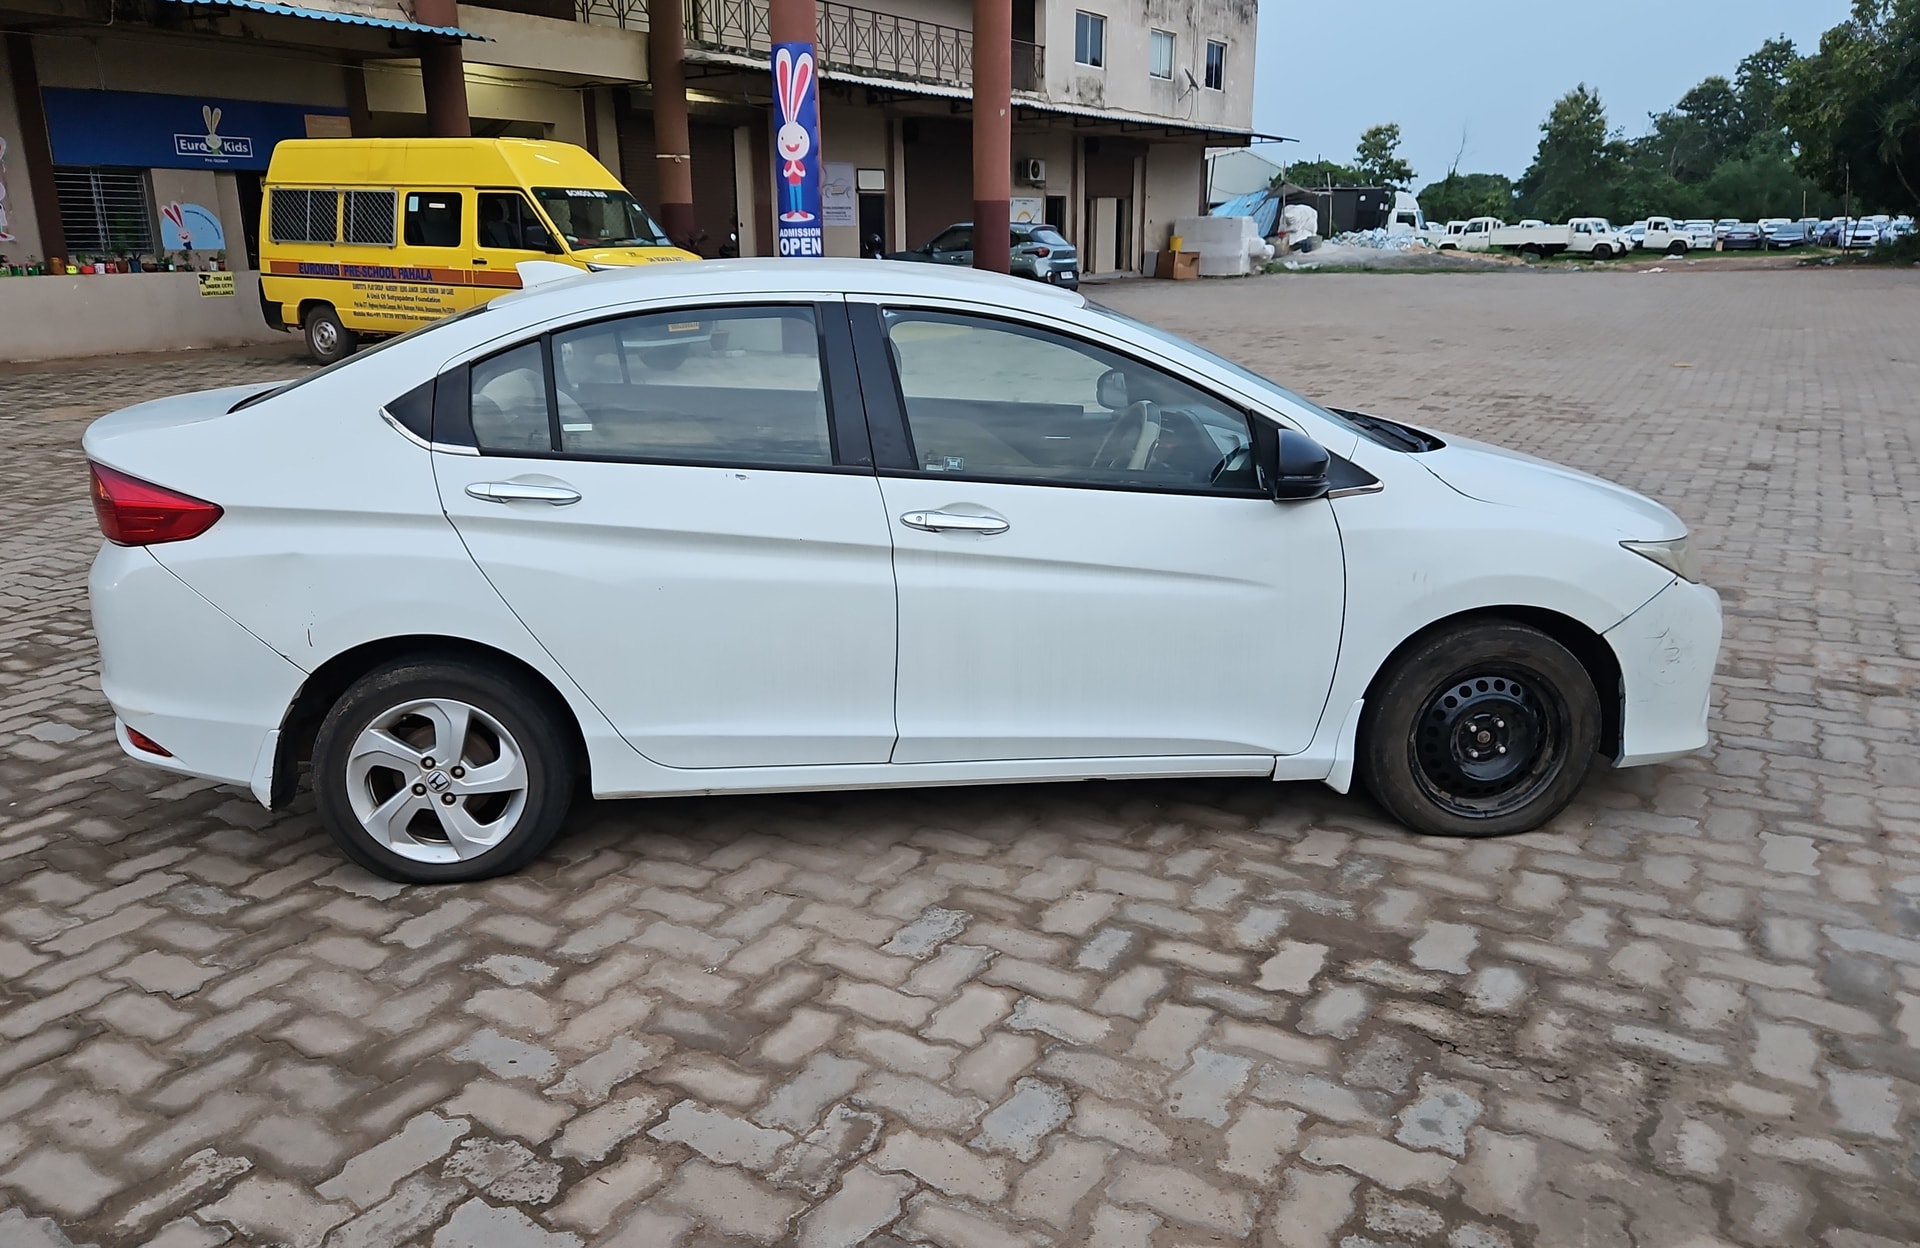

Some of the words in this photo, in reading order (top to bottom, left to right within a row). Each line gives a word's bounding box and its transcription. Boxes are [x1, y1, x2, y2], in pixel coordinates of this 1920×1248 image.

[180, 139, 207, 151] Euro
[223, 141, 249, 153] Kids
[779, 227, 821, 237] ADMISSION
[780, 237, 822, 256] OPEN
[299, 262, 340, 276] EUROKIDS
[398, 267, 433, 281] PAHALA
